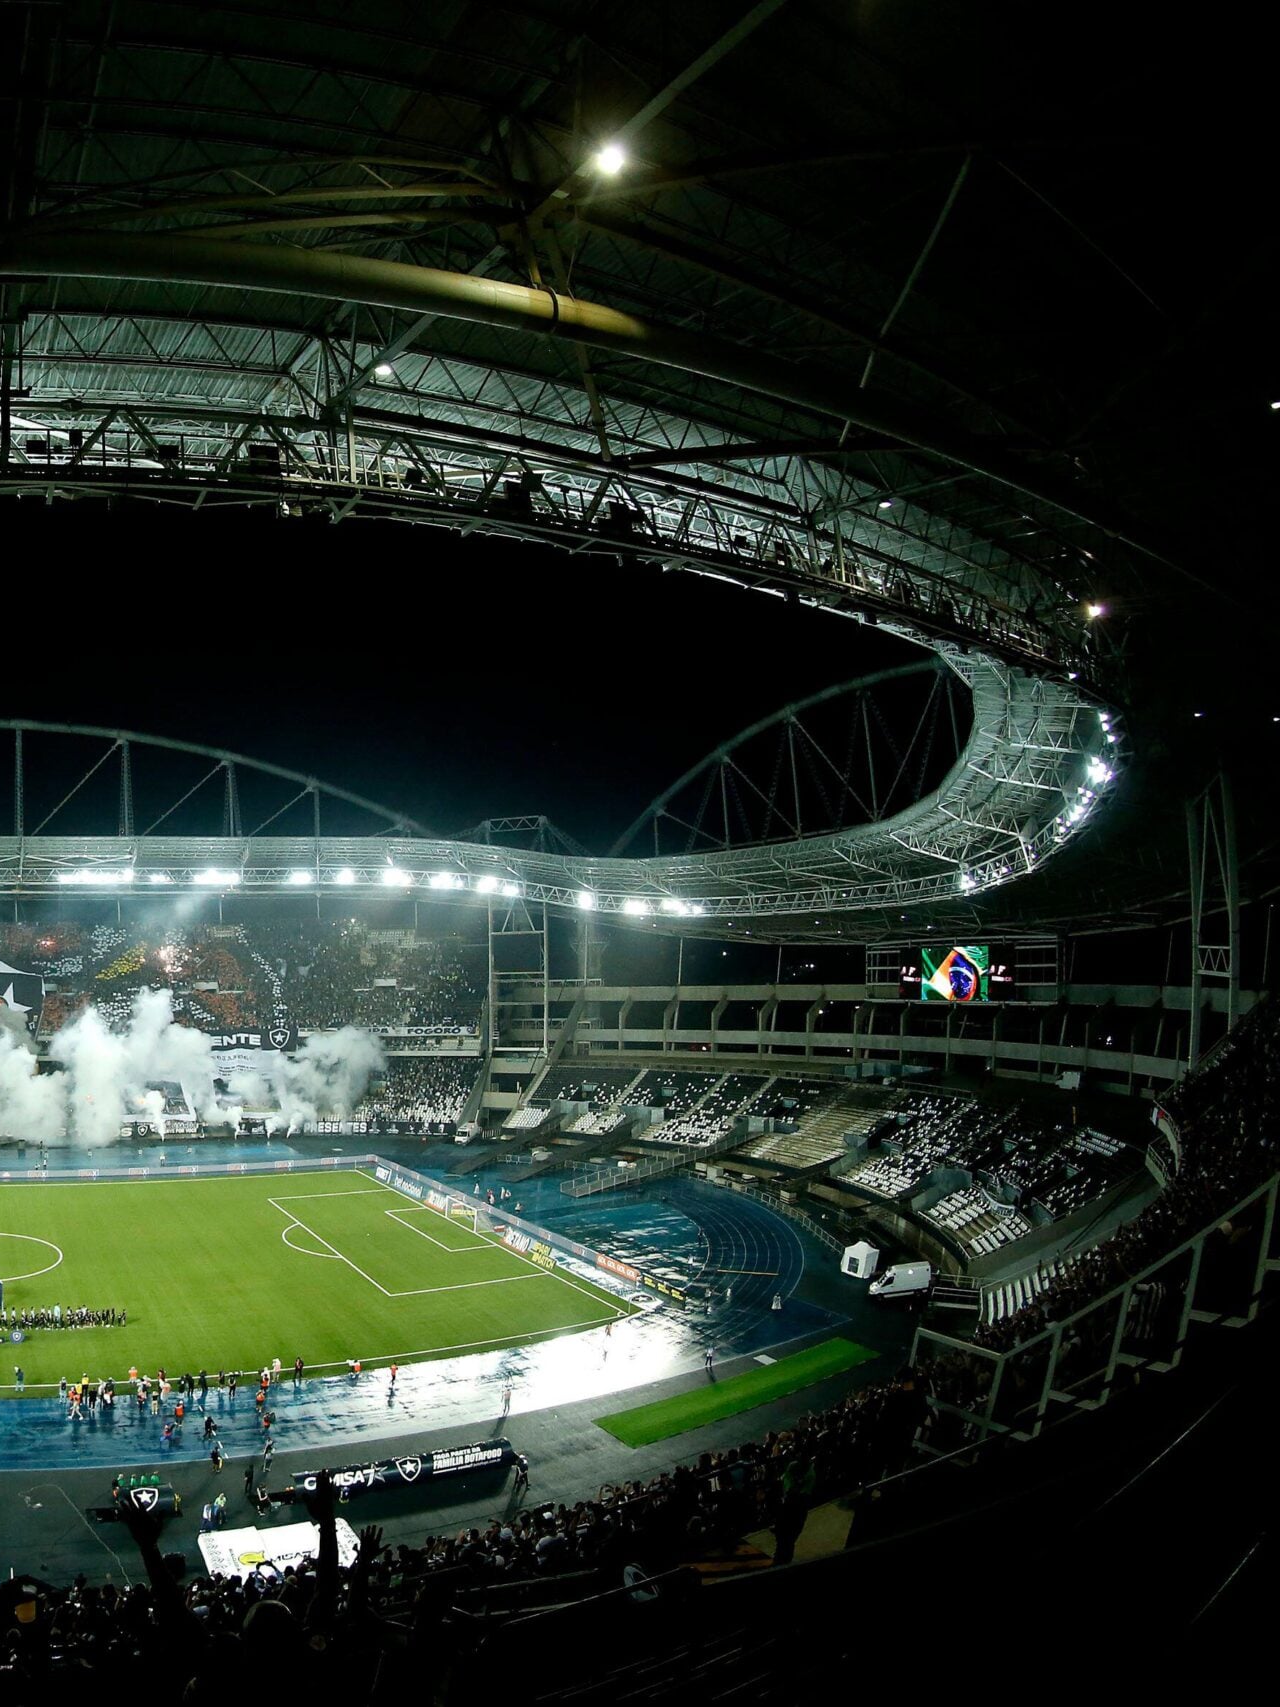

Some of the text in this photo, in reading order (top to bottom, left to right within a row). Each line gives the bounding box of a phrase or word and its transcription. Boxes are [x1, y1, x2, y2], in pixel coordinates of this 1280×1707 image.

[210, 1033, 261, 1047] ENTE
[464, 1447, 503, 1464] BOTAFOGO
[304, 1468, 375, 1491] CMISA7
